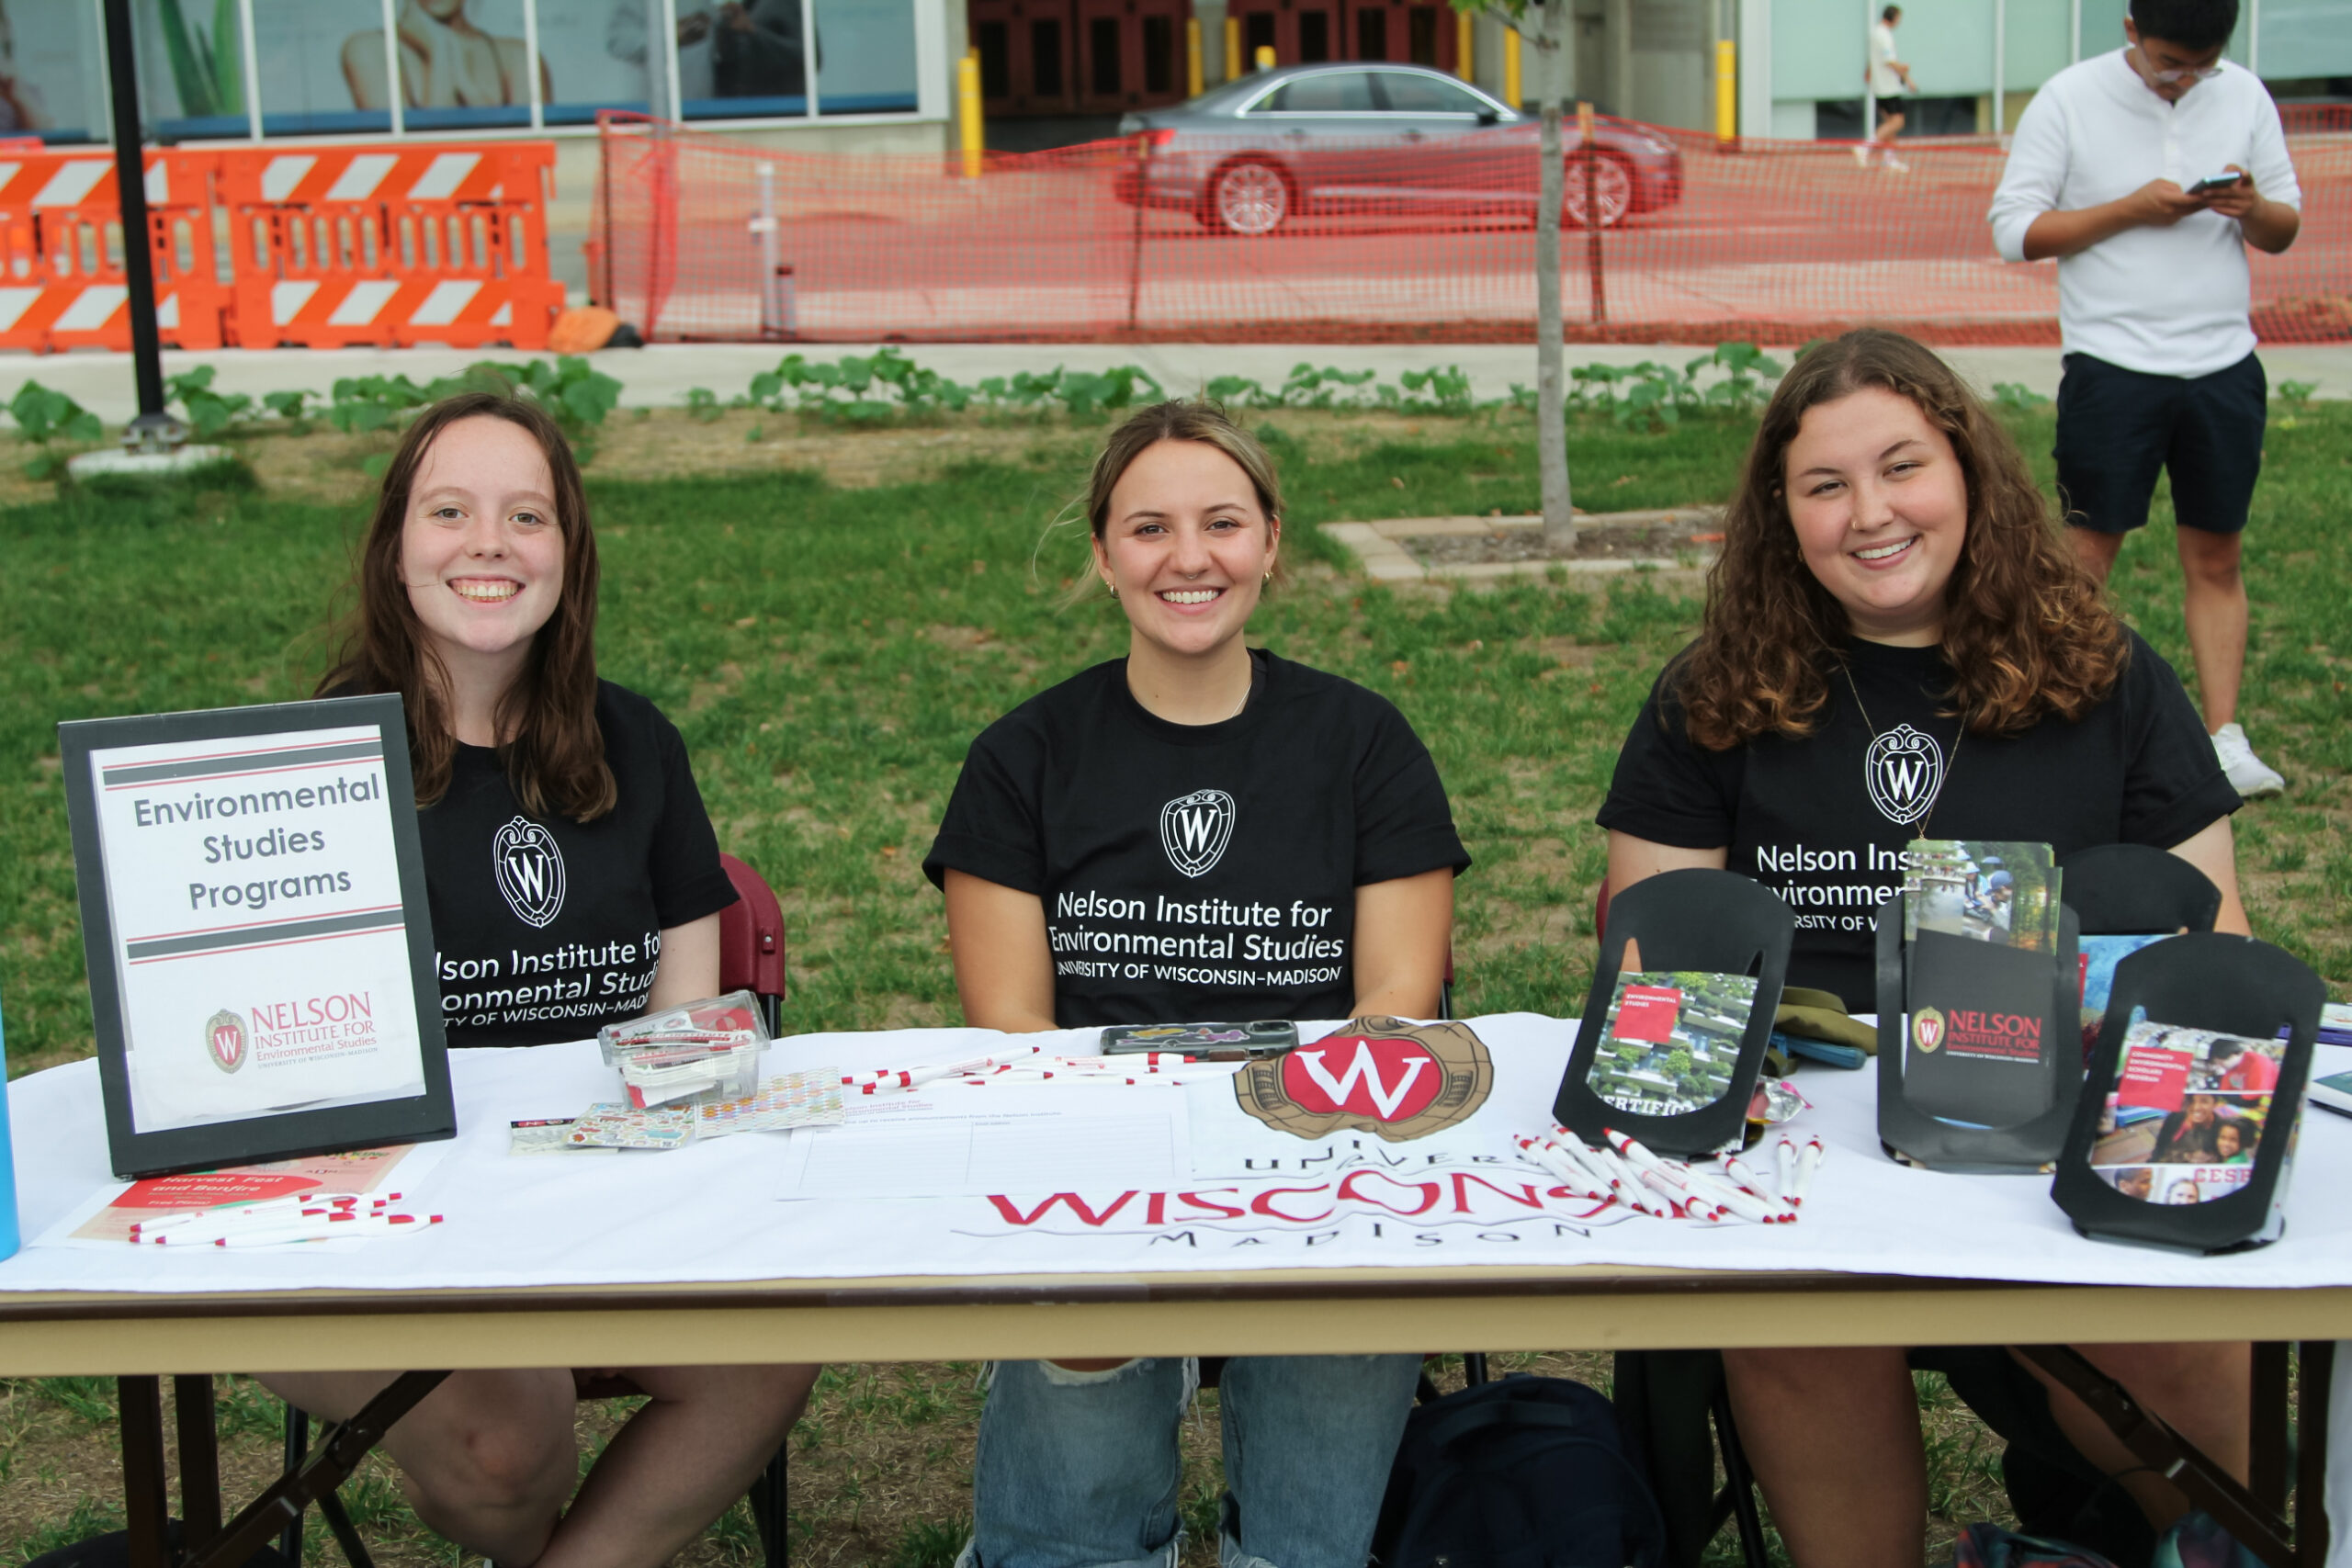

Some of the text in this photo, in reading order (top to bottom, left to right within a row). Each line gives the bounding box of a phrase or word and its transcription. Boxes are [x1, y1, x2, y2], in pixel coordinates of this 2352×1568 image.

[1885, 758, 1924, 801] W
[134, 773, 379, 827] Environmental
[203, 827, 325, 863] Studies
[1180, 807, 1217, 852] W
[1757, 843, 1857, 872] Nelson
[189, 871, 351, 910] Programs
[508, 852, 544, 902] W
[1749, 878, 1905, 906] vironme
[1057, 890, 1332, 928] Nelson Institute for
[1794, 915, 1837, 930] RSITY
[1841, 916, 1864, 931] OF
[435, 931, 661, 980] lson Institute fo
[1048, 924, 1344, 961] Environmental Studies
[441, 962, 659, 1012] onmental Studi
[1124, 963, 1149, 979] OF
[1154, 964, 1342, 987] WISCONSIN-MADISON
[251, 991, 372, 1033] NELSON
[471, 1011, 497, 1027] OF
[503, 994, 650, 1022] WISCONSIN-MAD
[1949, 1010, 2041, 1038] NELSON
[216, 1030, 238, 1061] W
[254, 1020, 376, 1049] INSTITUTE FOR
[1920, 1021, 1938, 1044] W
[1948, 1032, 2040, 1049] INSTITUTE FOR
[257, 1036, 377, 1061] Environmental Studies
[258, 1058, 297, 1069] UNIVERSITY
[1295, 1040, 1430, 1120] W
[1600, 1094, 1696, 1116] ERTIFIC
[1245, 1139, 1540, 1171] UNIVER
[192, 1184, 261, 1193] Bonfire
[1149, 1224, 1591, 1247] MADISON
